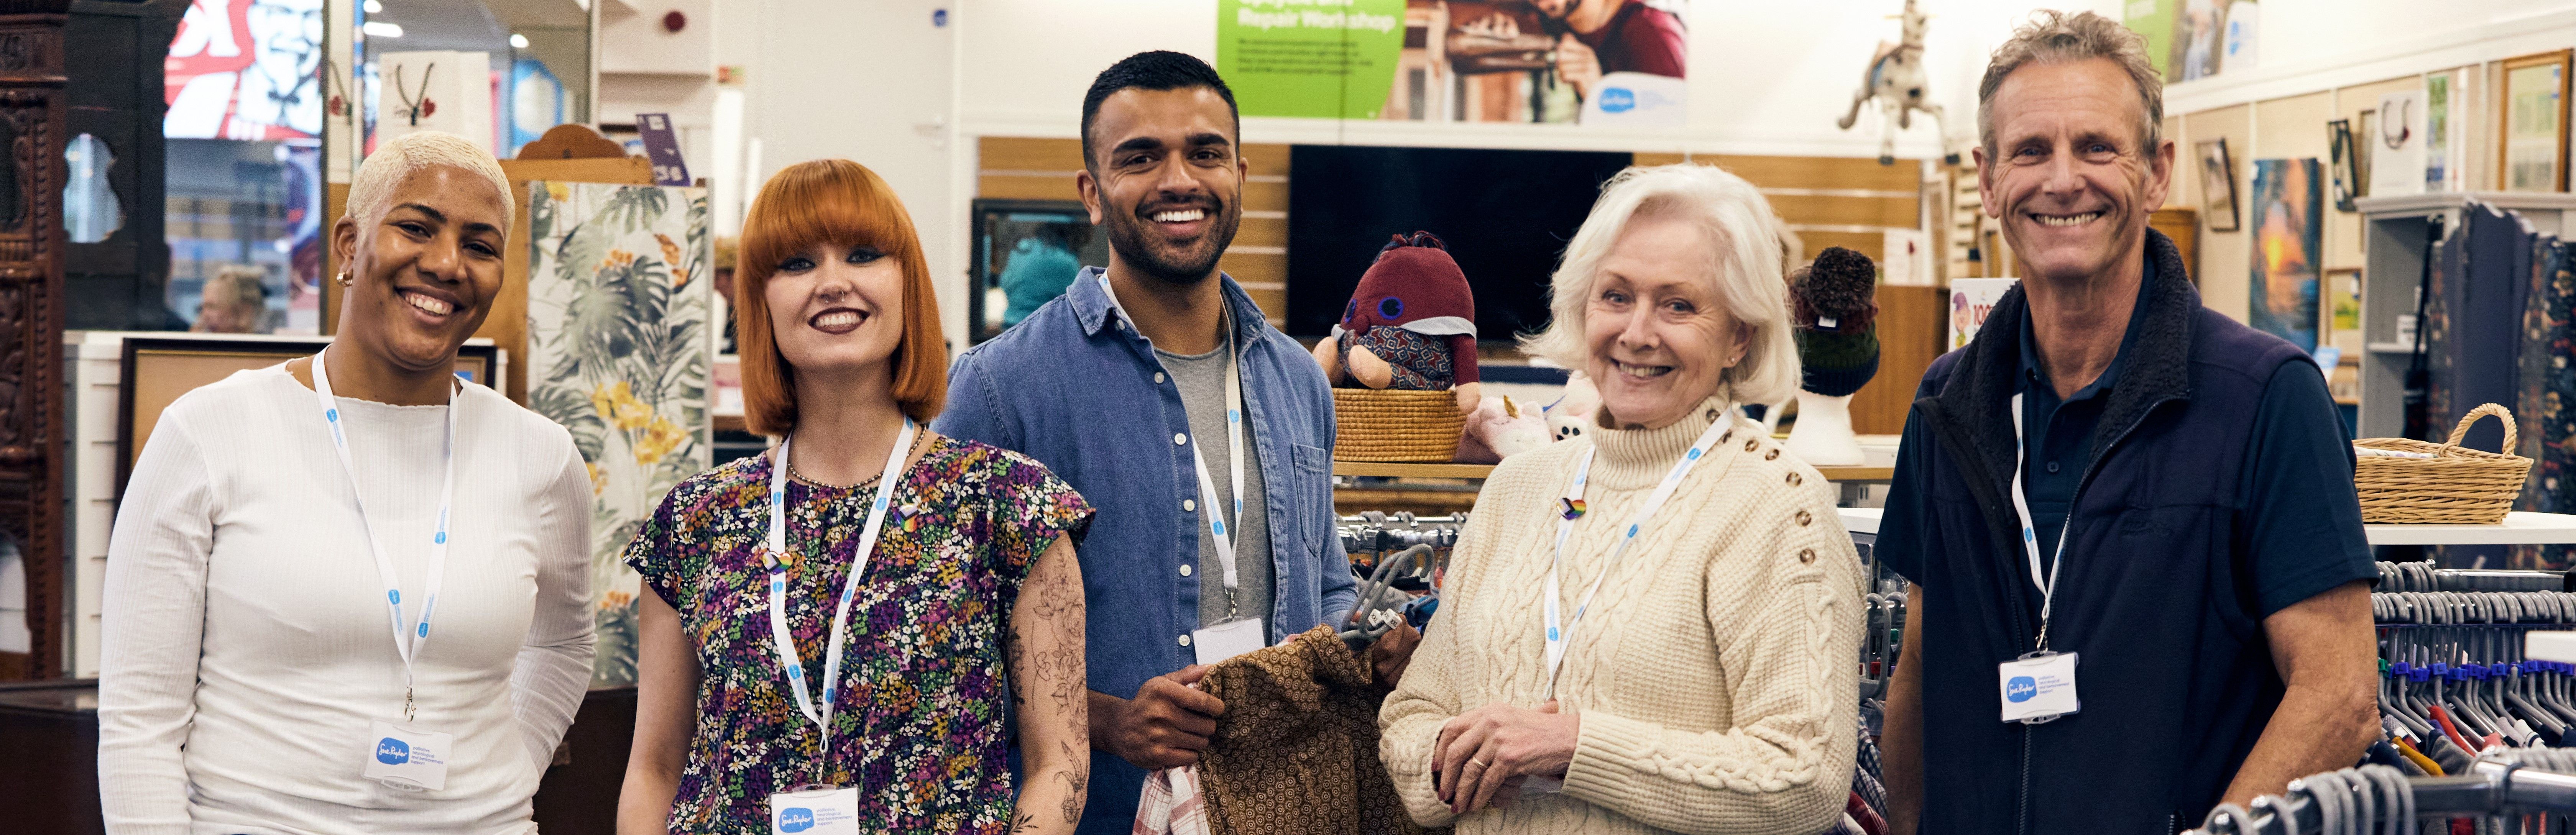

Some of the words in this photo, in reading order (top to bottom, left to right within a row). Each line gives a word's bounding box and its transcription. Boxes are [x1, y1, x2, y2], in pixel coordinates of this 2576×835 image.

[1238, 8, 1298, 31] Repair
[1301, 10, 1396, 34] Workshop
[379, 743, 390, 755] Sue
[390, 746, 407, 760] Ryder
[782, 814, 794, 827] Sue
[794, 814, 812, 826] Ryder
